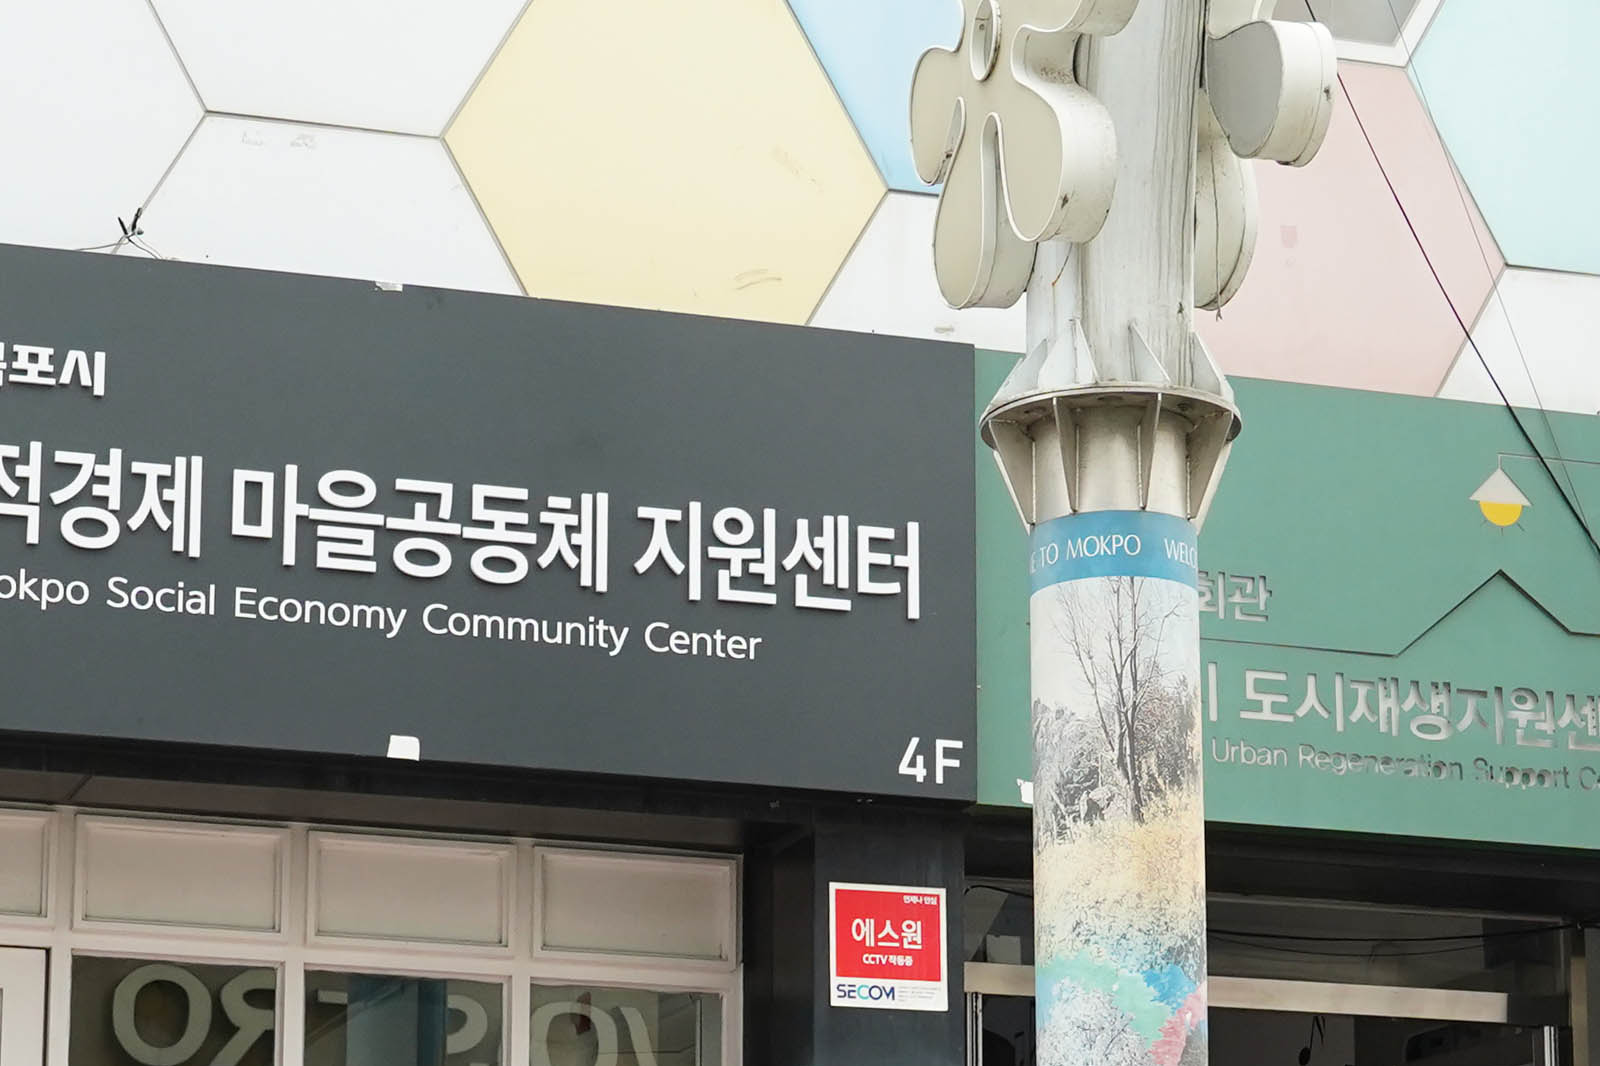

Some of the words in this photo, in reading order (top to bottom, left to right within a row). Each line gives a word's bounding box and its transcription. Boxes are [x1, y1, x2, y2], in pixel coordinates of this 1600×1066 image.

[231, 463, 610, 593] 마을공동체
[633, 500, 920, 620] 지원센터
[1040, 543, 1059, 568] TO
[1066, 534, 1142, 561] MOKPO
[106, 576, 216, 616] Social
[234, 586, 408, 639] Economy
[422, 603, 630, 657] Community
[644, 621, 763, 660] Center
[898, 736, 964, 785] 4F
[1212, 736, 1288, 767] Urban
[1299, 743, 1464, 782] Regeneration
[1473, 757, 1570, 791] Support
[851, 918, 923, 950] 에스원
[862, 953, 888, 965] CCTV
[888, 954, 913, 967] 작동중
[837, 984, 895, 1001] SECOM
